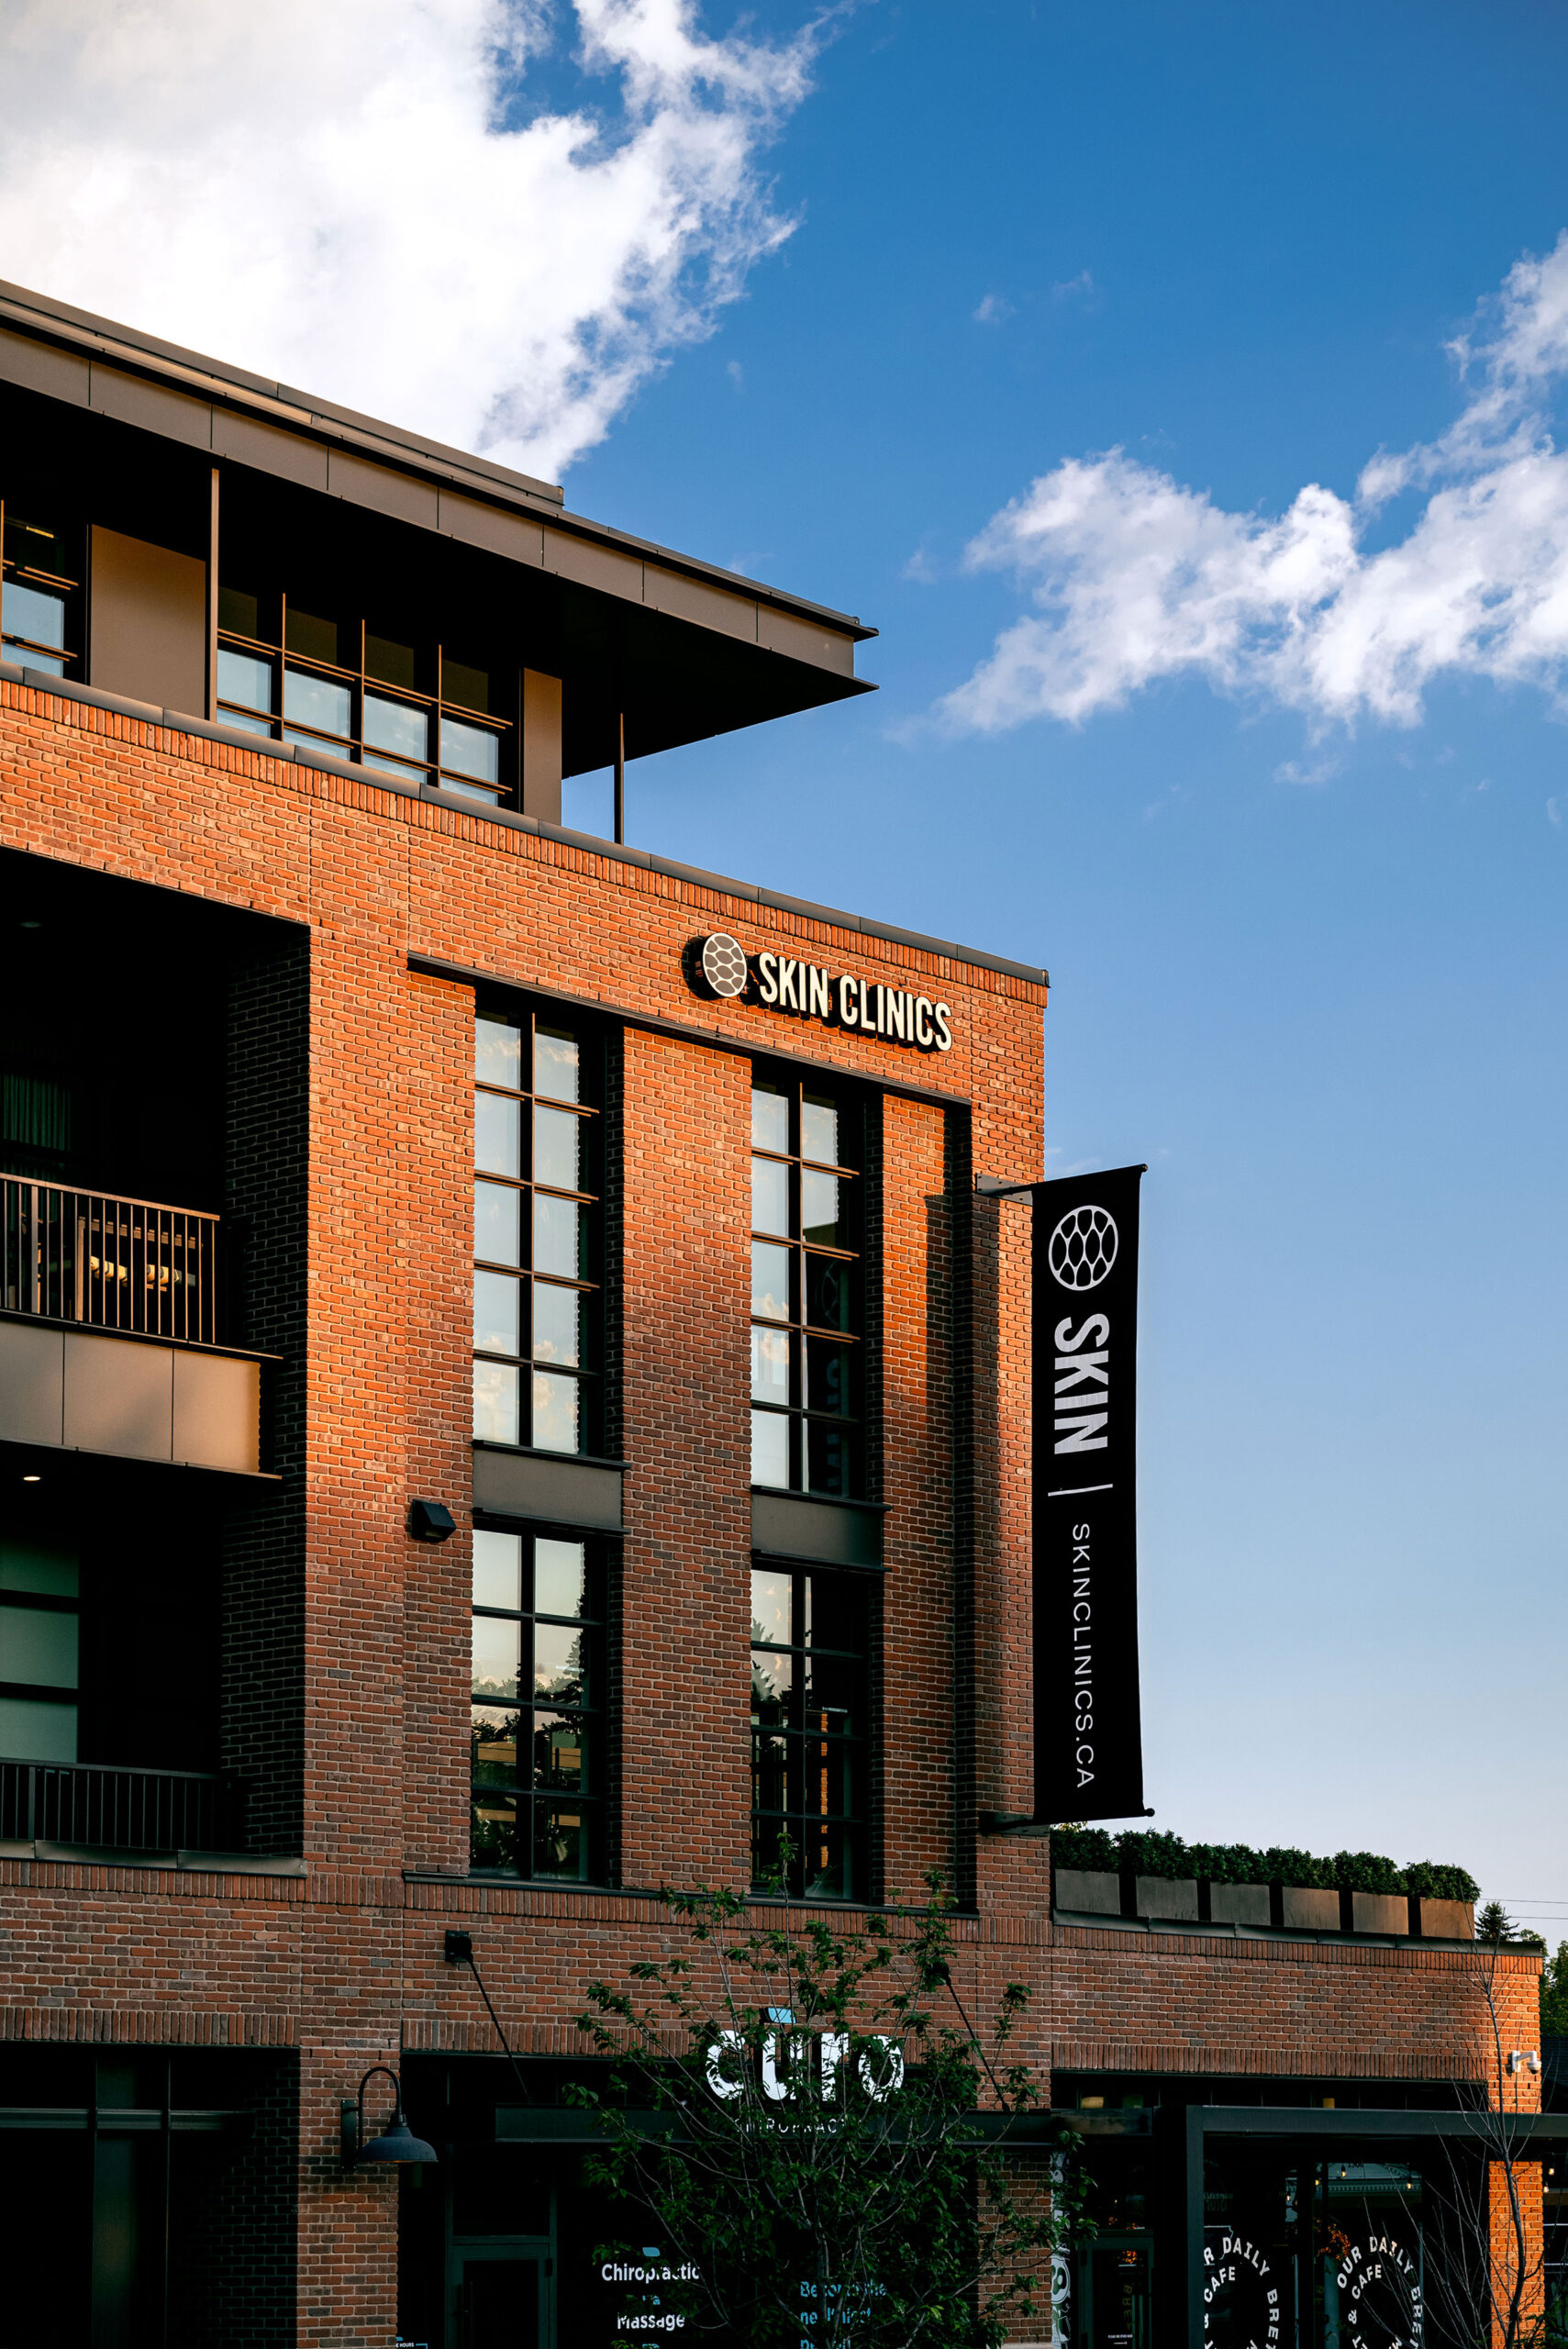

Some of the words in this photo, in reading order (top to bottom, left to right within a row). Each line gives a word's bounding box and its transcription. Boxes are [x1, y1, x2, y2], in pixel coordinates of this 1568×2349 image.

[759, 952, 828, 1018] SKIN
[840, 974, 952, 1052] CLINICS
[1053, 1312, 1110, 1455] SKIN
[1072, 1523, 1095, 1788] SKINCLINICS.CA
[1222, 2237, 1271, 2277] DAILY
[1337, 2245, 1362, 2288] OUR
[1369, 2236, 1414, 2274] DAILY
[1204, 2266, 1236, 2303] CAFE
[1351, 2264, 1382, 2299] CAFE
[1348, 2309, 1357, 2324] &
